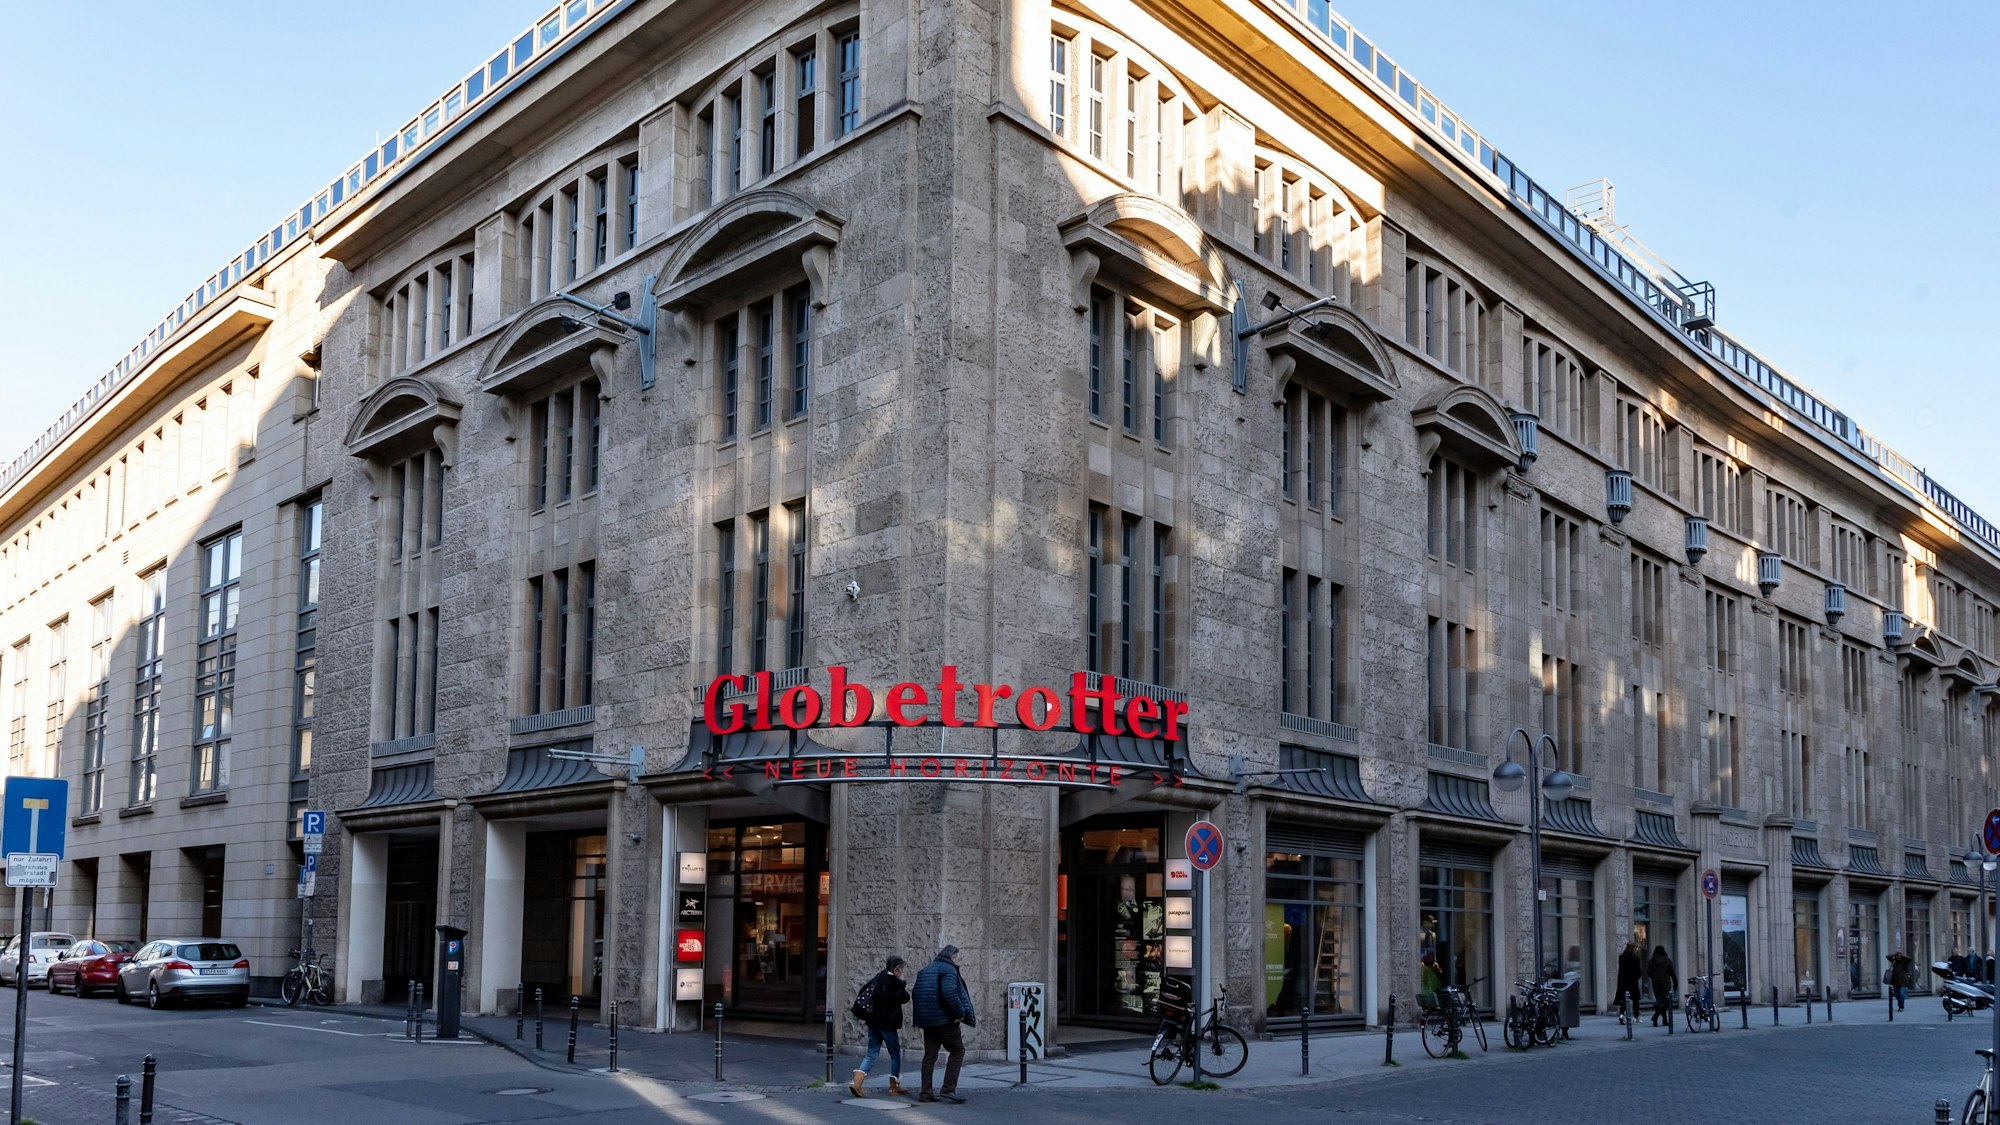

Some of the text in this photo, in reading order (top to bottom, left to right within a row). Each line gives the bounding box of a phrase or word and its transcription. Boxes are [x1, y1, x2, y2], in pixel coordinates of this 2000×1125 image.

[703, 666, 1188, 741] Globetrotter
[765, 757, 1121, 785] NEUE HORIZONTE
